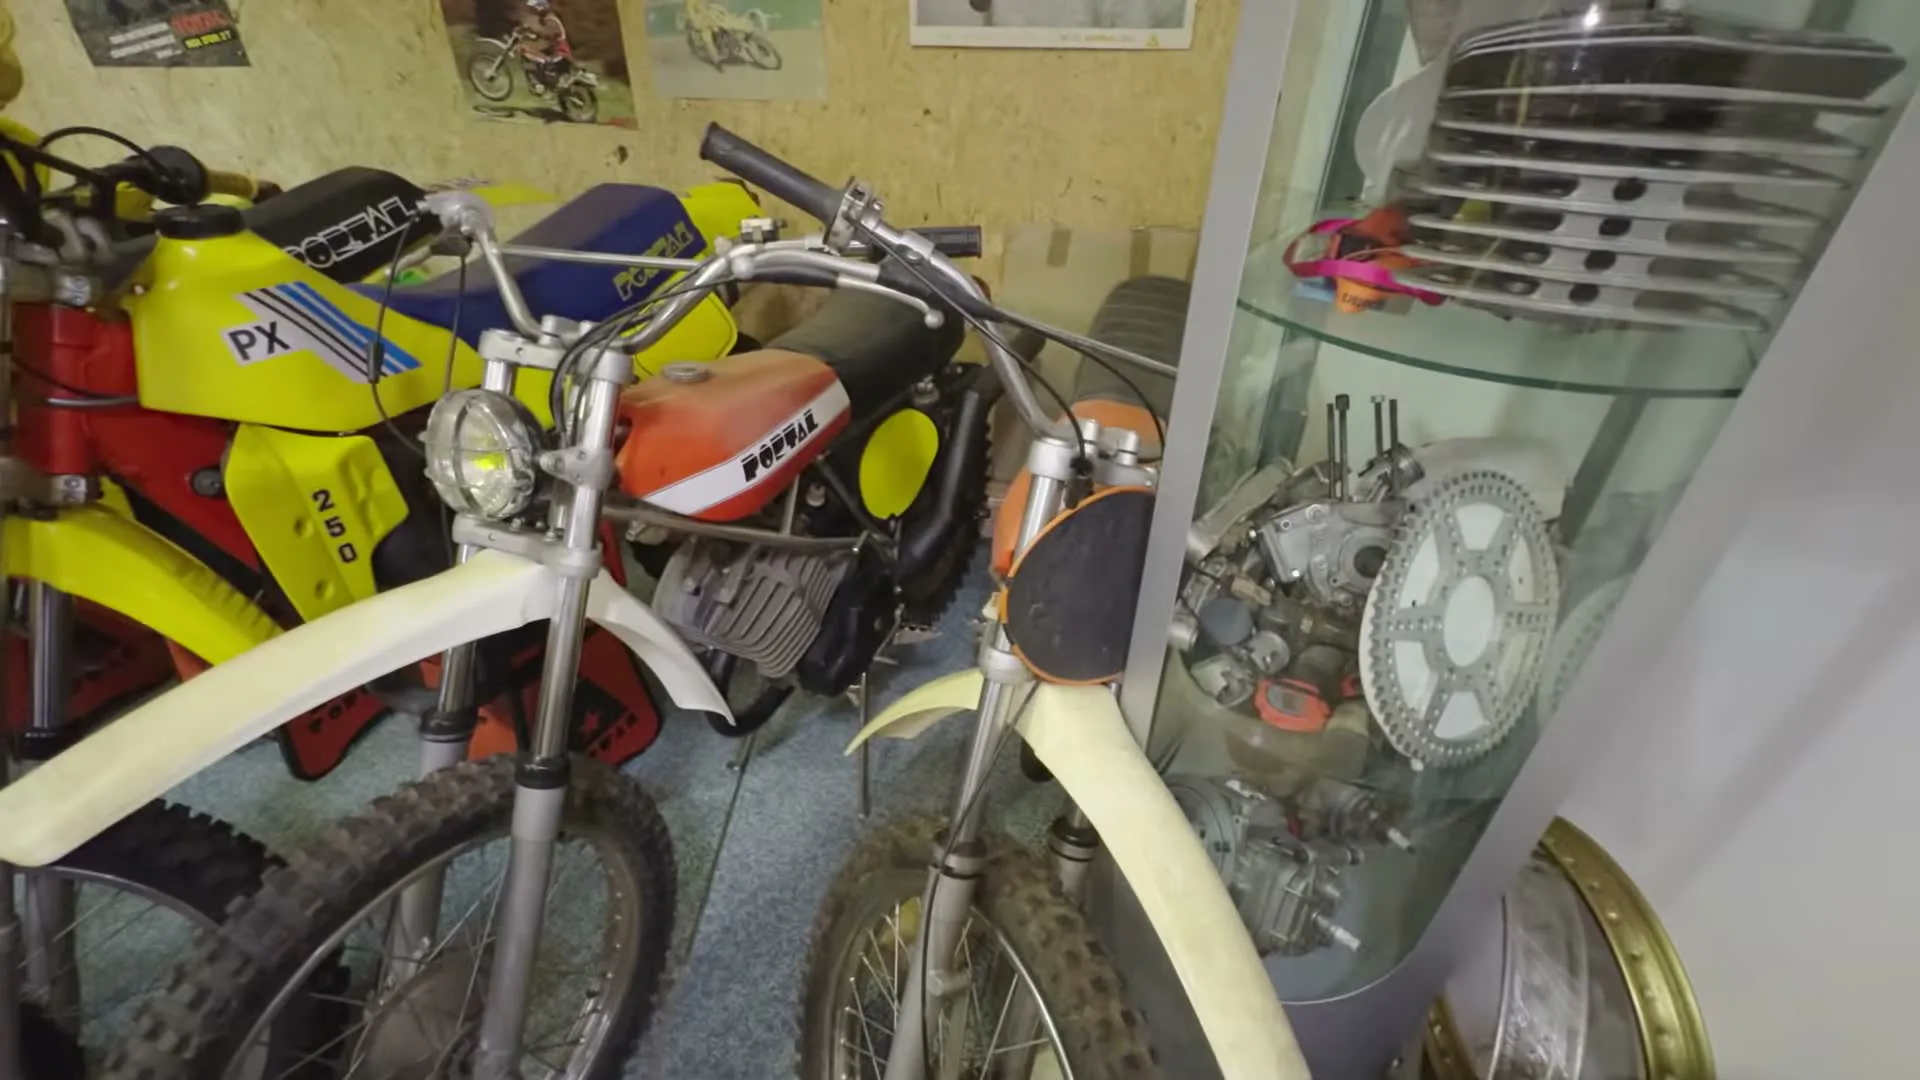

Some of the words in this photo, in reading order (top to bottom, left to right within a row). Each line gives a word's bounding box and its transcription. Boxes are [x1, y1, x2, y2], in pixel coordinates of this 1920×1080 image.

[228, 321, 292, 361] PX
[741, 408, 818, 482] PORTAL
[312, 489, 357, 563] 250
